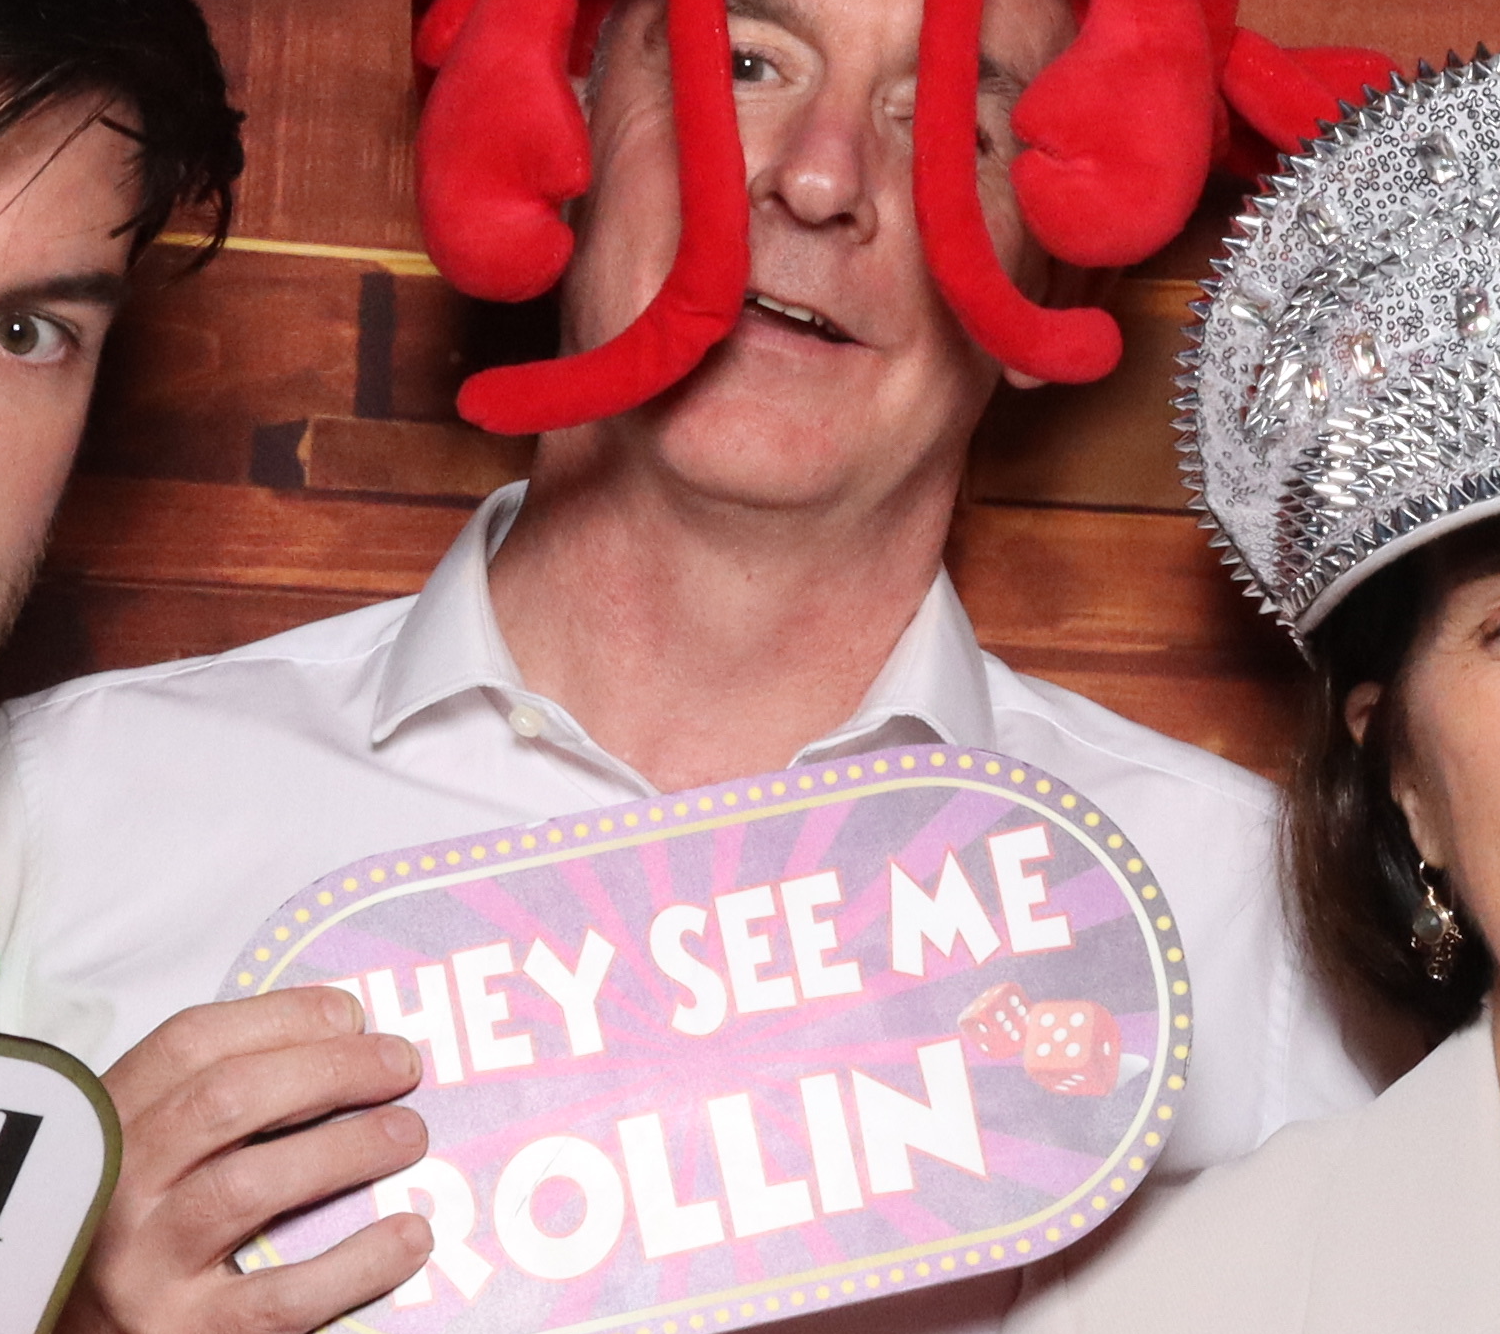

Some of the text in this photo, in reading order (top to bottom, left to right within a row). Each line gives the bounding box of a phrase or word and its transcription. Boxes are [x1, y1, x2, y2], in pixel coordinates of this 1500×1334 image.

[298, 823, 1075, 1087] HEY SEE ME
[369, 1037, 990, 1311] ROLLIN
